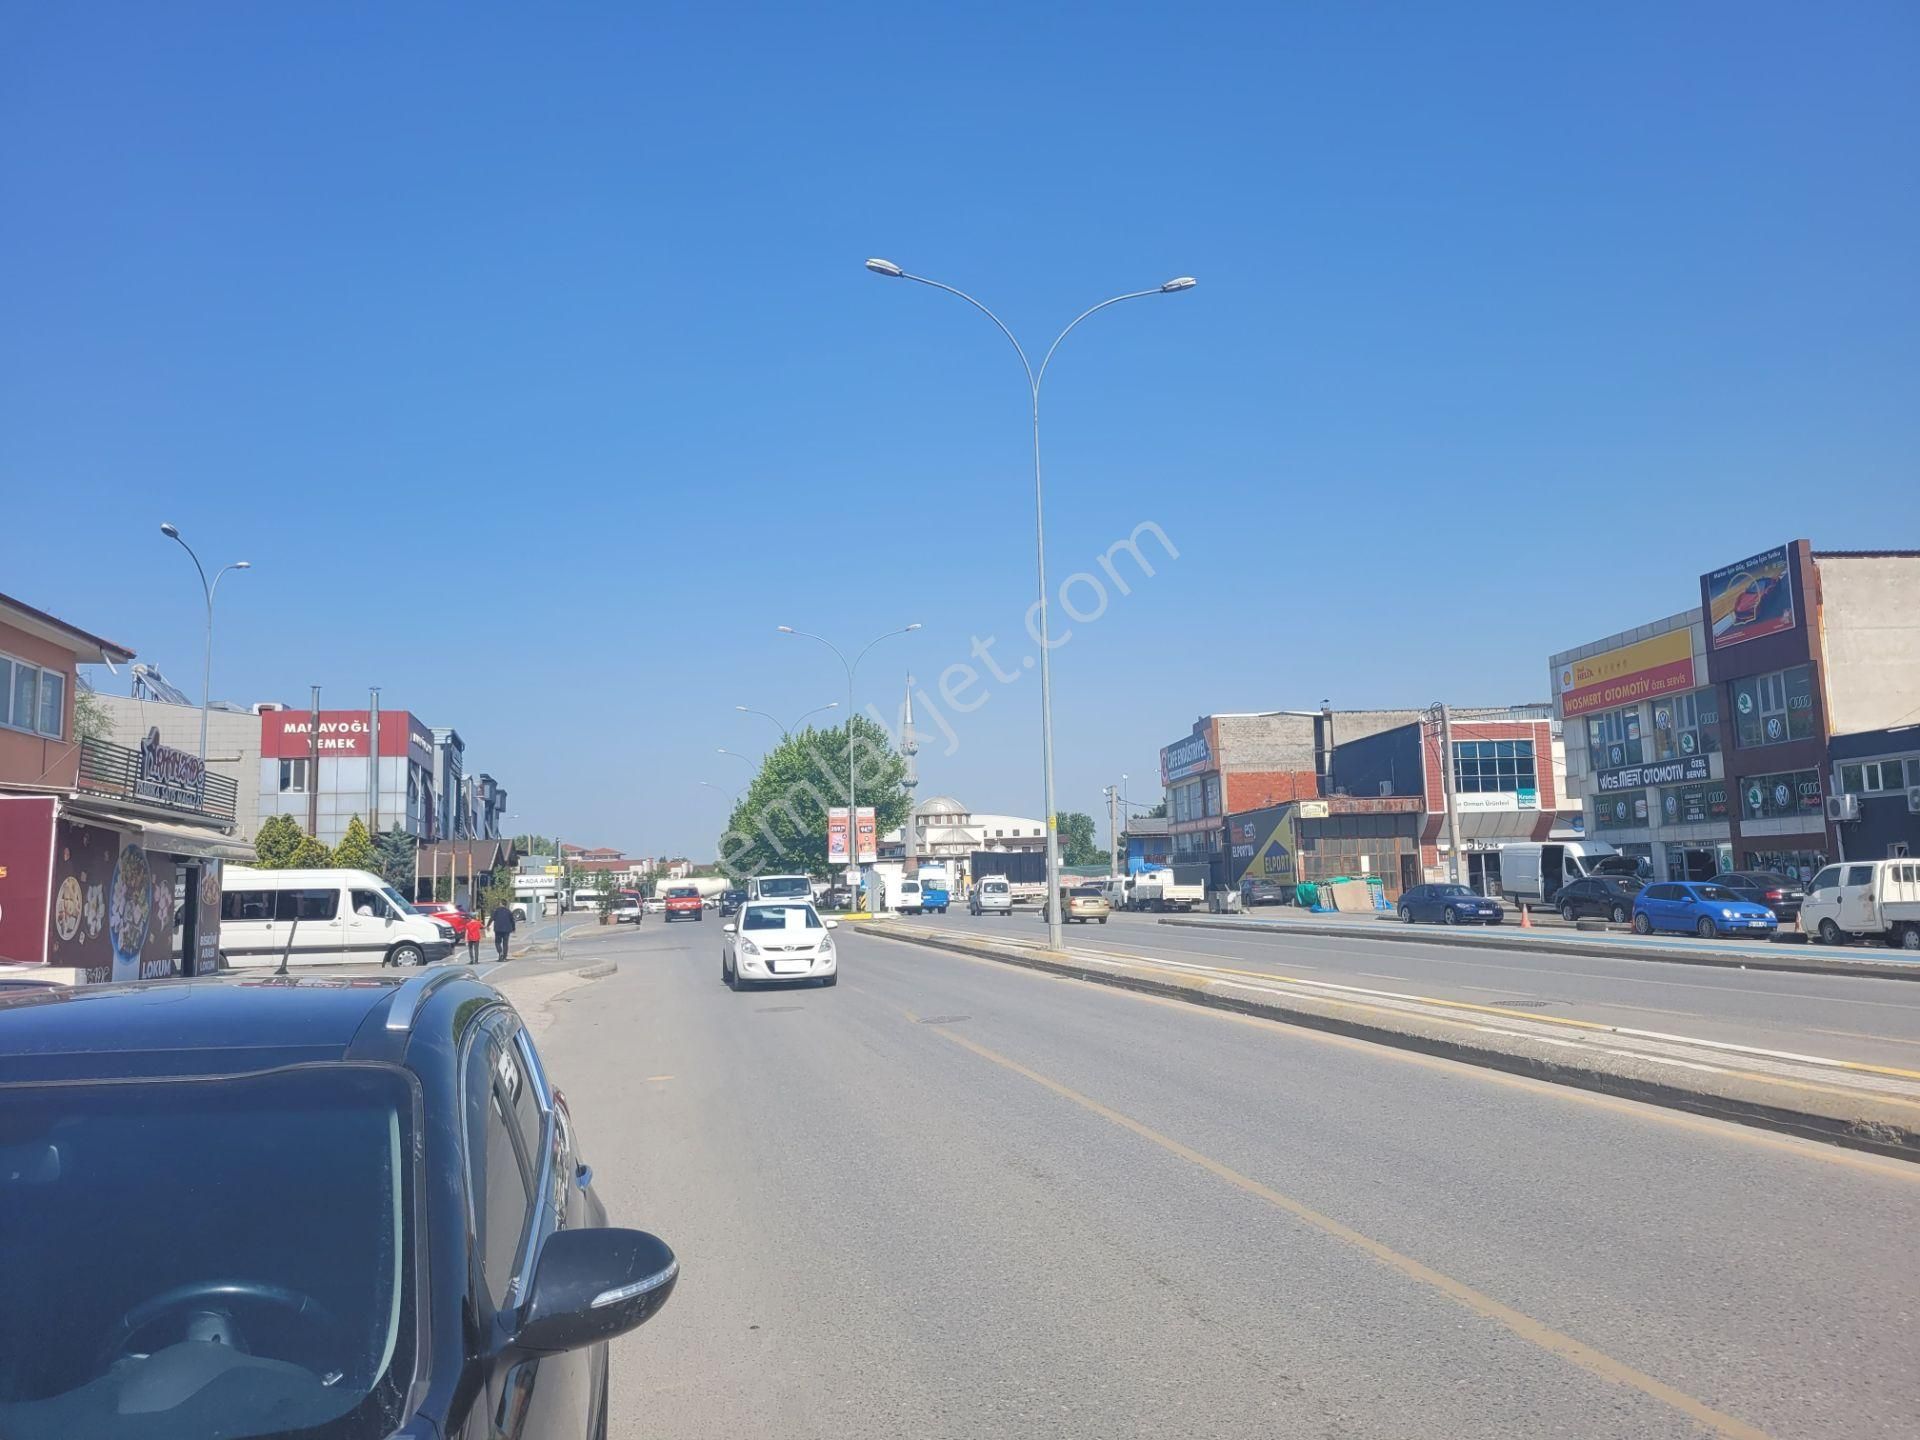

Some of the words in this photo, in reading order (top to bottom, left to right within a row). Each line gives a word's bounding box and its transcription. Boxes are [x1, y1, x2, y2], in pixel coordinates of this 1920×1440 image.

[1564, 692, 1602, 712] WOSMERT
[1604, 676, 1650, 702] OTOMOTİV
[1651, 681, 1665, 690] ÖZEL
[1666, 673, 1686, 687] SERVİS
[284, 720, 380, 733] MAAVOĞL
[1690, 758, 1706, 768] ÖZEL
[1643, 763, 1683, 784] OTOMOTİV
[1686, 768, 1707, 780] SERVİS
[1264, 854, 1290, 872] ELPORT
[142, 960, 171, 978] LOKUM
